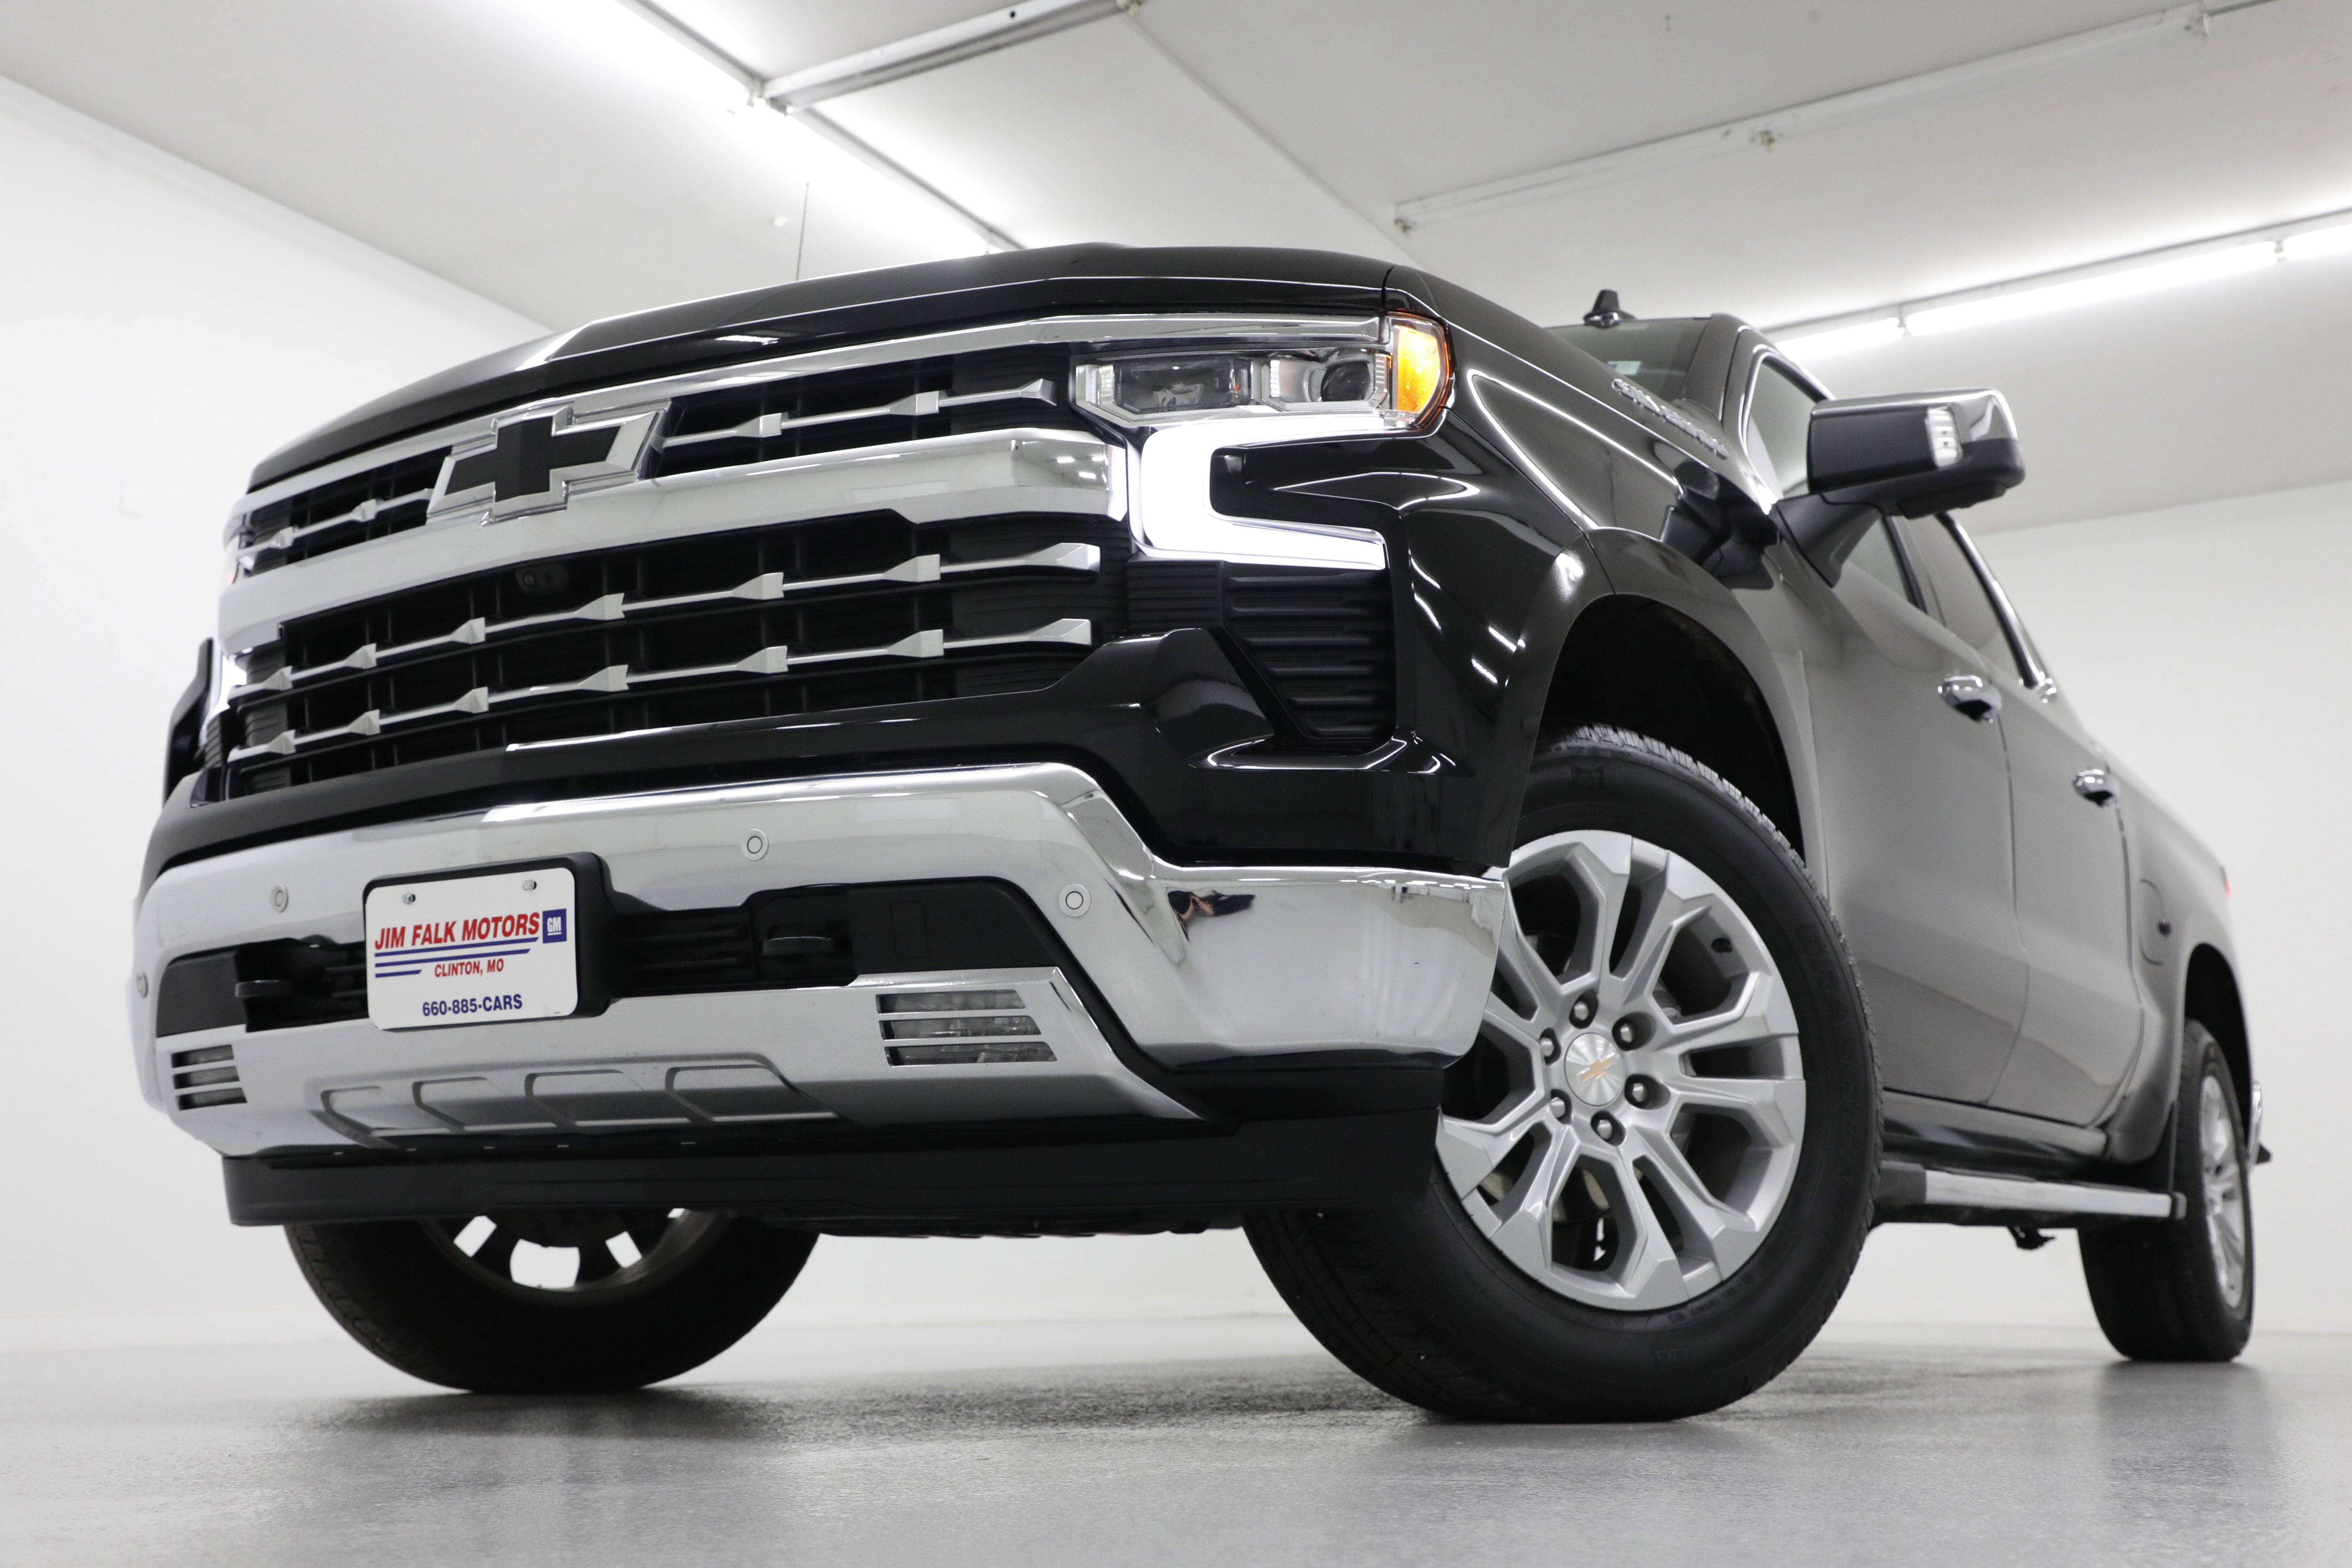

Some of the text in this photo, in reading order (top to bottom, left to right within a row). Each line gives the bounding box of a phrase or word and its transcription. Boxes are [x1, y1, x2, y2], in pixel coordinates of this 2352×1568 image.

[375, 912, 541, 950] JIM FALK MOTORS
[547, 918, 561, 932] GM
[434, 958, 504, 978] CLINTON, MO
[422, 994, 523, 1016] 660-885-CARS
